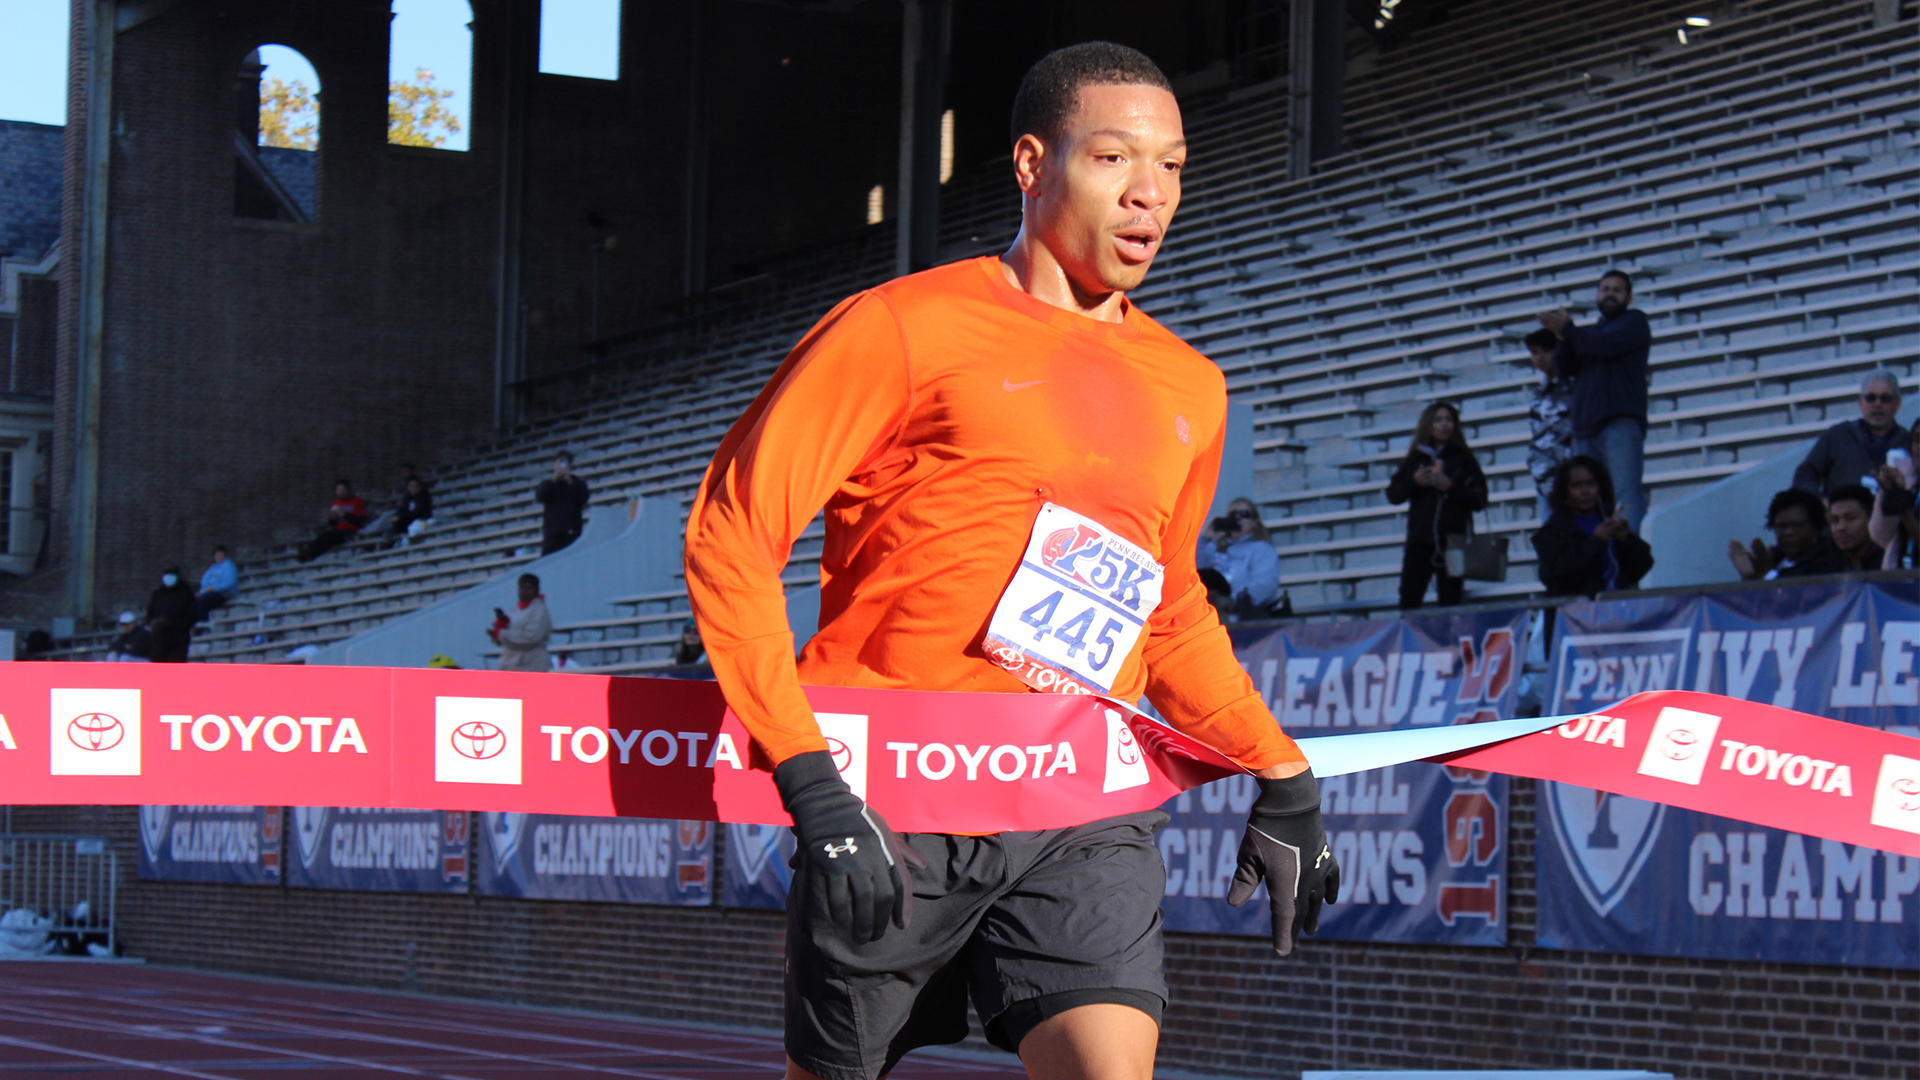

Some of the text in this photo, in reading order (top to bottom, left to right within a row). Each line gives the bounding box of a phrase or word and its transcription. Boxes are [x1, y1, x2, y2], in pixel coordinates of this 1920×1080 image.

[1089, 546, 1156, 612] 5K
[1108, 538, 1159, 573] PENN RELAYS
[1019, 590, 1124, 672] 445
[1025, 661, 1096, 695] TOYO
[1259, 651, 1454, 728] LEAGUE
[1565, 652, 1675, 701] PENN
[1695, 627, 1815, 709] IVY
[159, 713, 368, 754] TOYOTA
[540, 725, 743, 770] TOYOTA
[886, 741, 1077, 782] TOYOTA
[1719, 739, 1853, 798] TOYOTA
[330, 822, 440, 870] CHAMPIONS
[534, 823, 671, 878] CHAMPIONS
[1159, 828, 1427, 905] CHAONS
[1688, 831, 1920, 924] CHAMP
